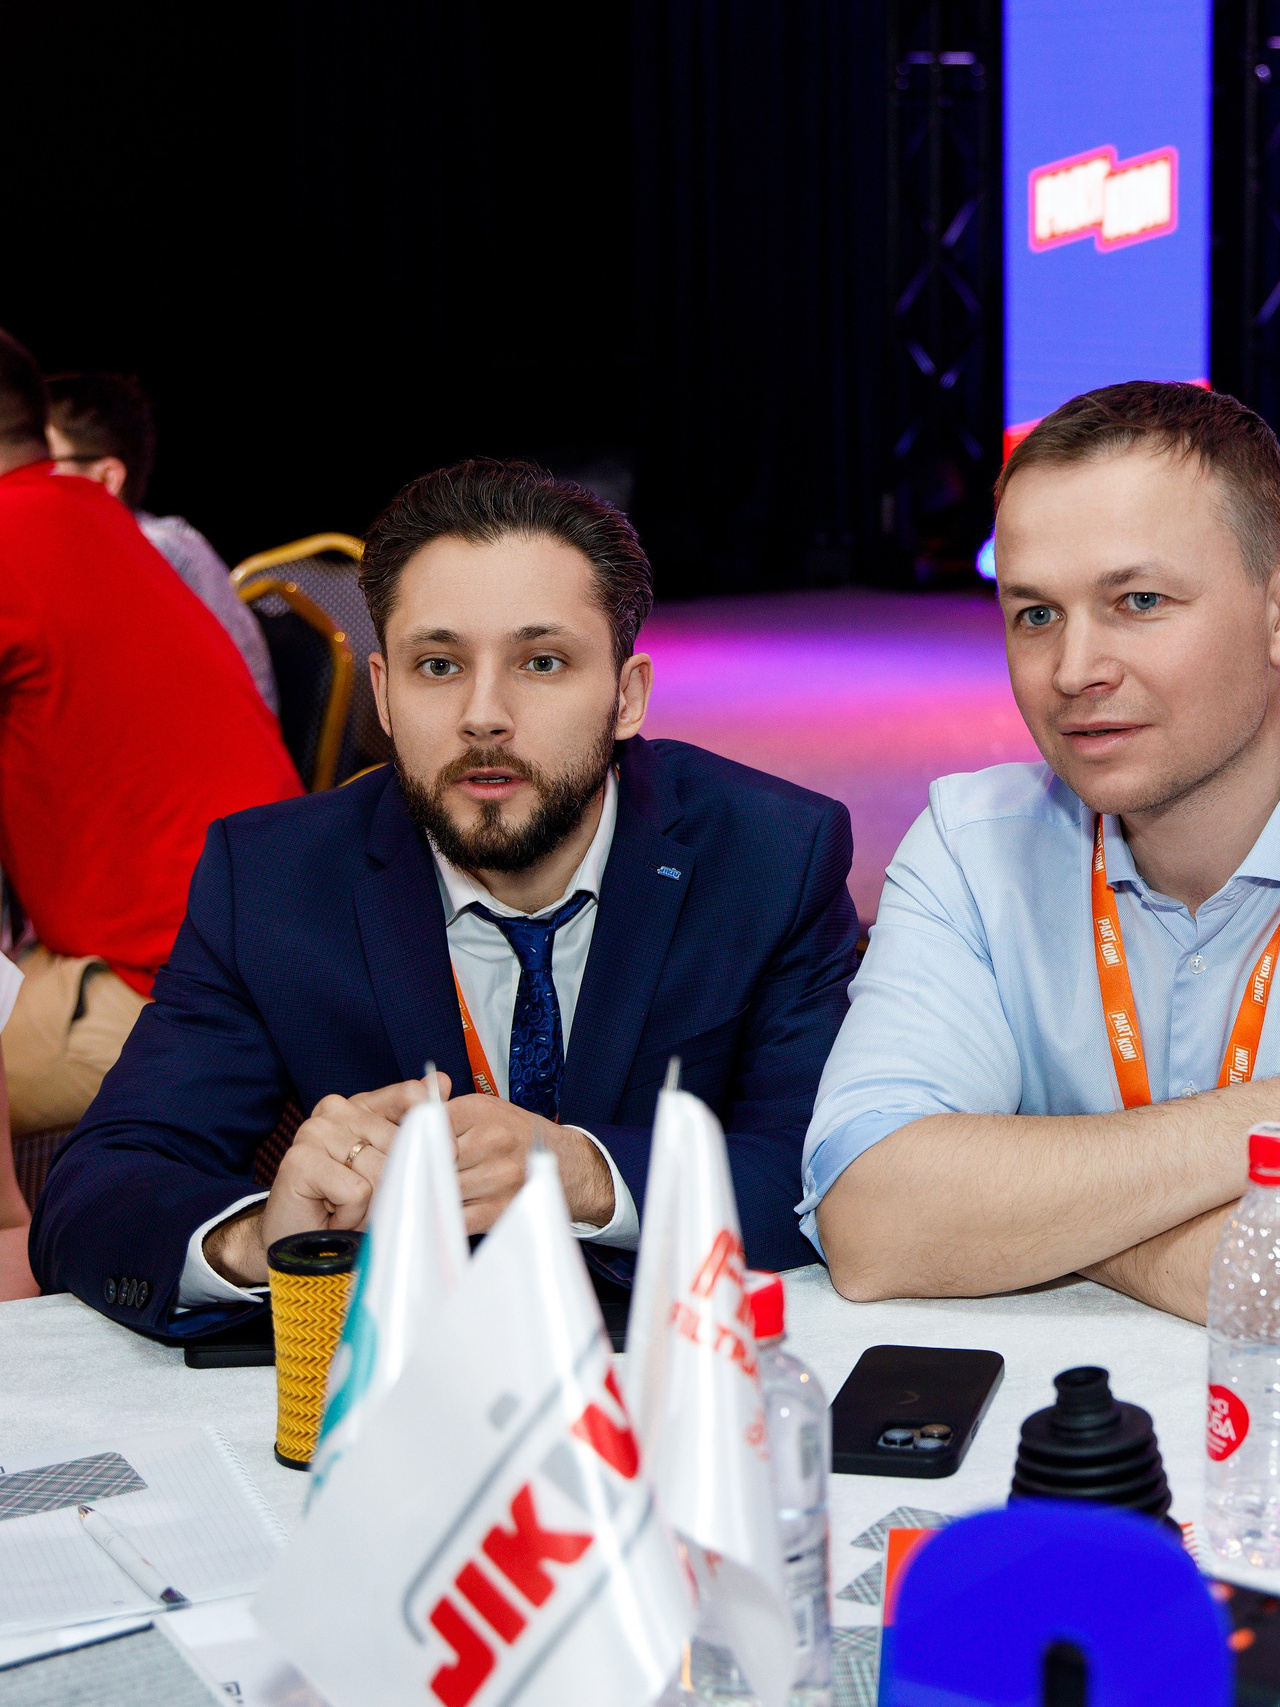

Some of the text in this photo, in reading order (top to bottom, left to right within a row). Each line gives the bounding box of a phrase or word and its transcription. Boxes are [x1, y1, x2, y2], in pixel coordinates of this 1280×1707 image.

[1098, 918, 1120, 965] PART KOM
[1254, 955, 1272, 1003] PART KOM
[1112, 1012, 1136, 1061] PART KOM
[1234, 1048, 1249, 1073] KOM
